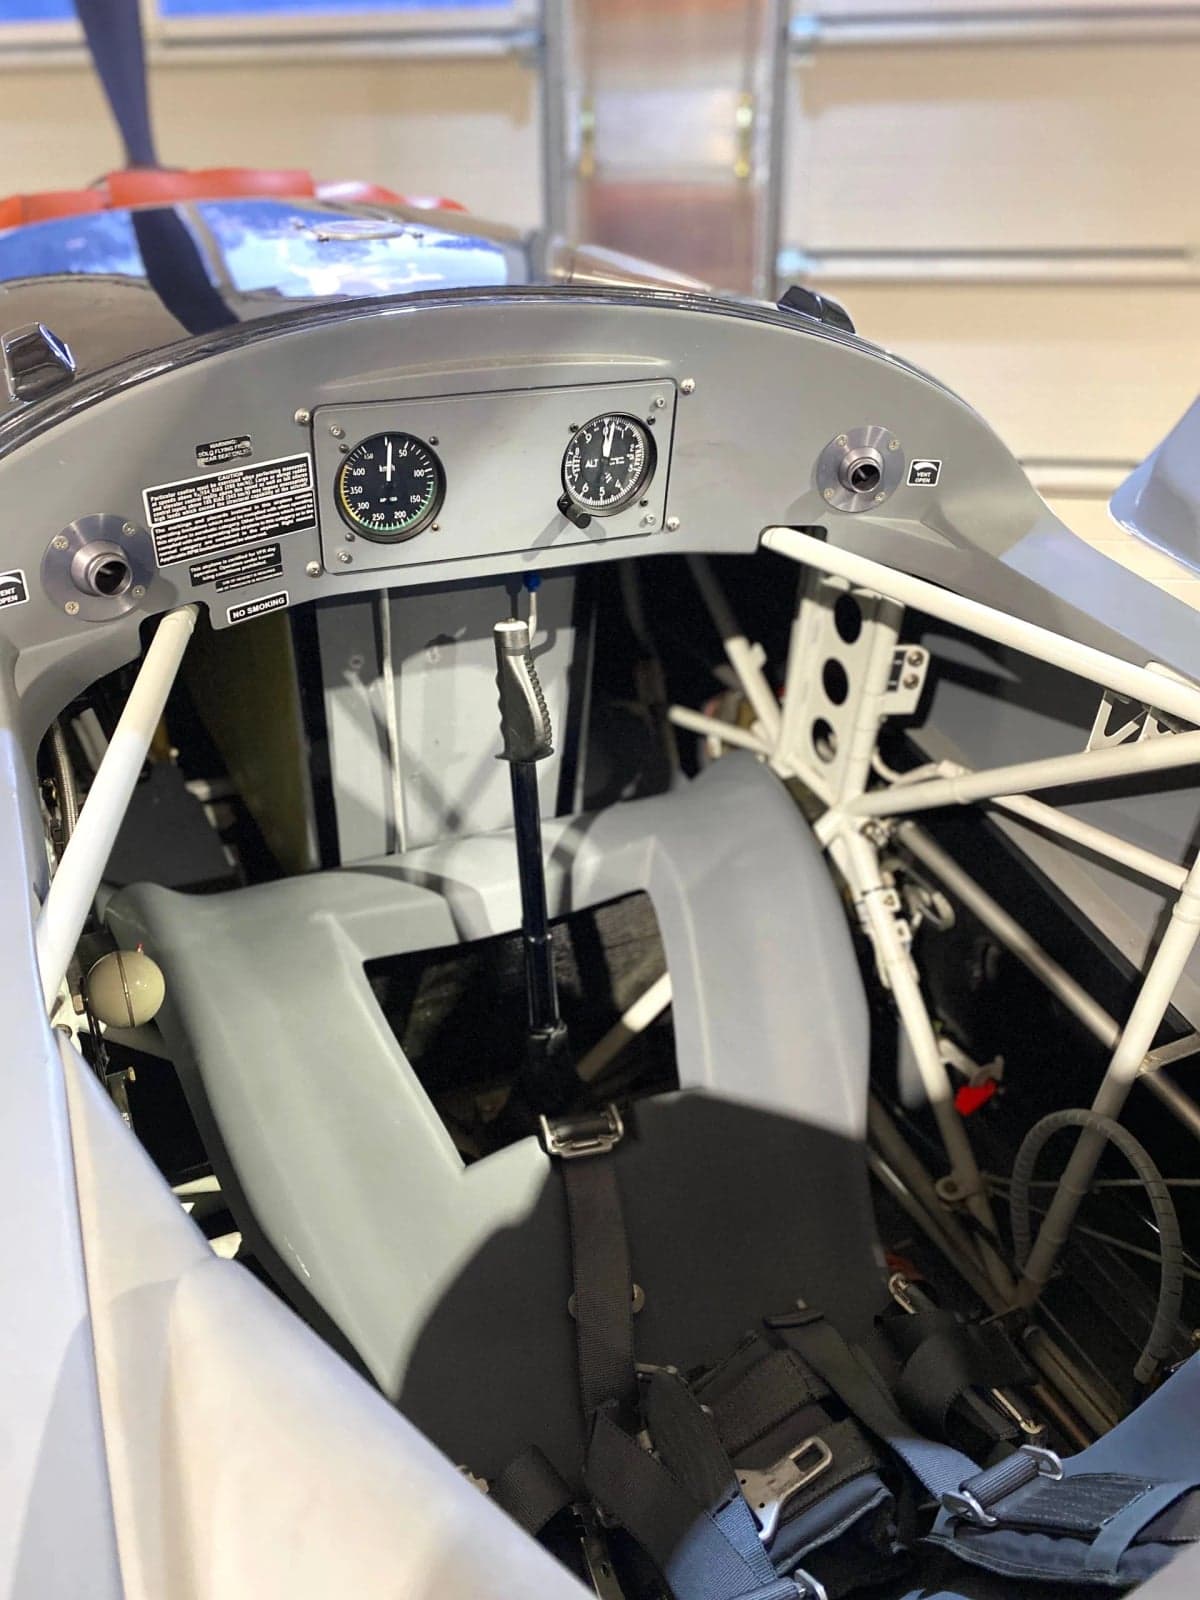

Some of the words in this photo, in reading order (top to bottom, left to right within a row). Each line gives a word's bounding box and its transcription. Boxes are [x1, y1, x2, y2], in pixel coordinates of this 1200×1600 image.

[585, 434, 592, 444] 9
[214, 446, 233, 454] FLYING
[585, 459, 599, 468] ALT
[350, 486, 362, 494] 350
[582, 483, 589, 492] 6
[0, 587, 16, 596] ENT
[233, 610, 245, 618] NO
[247, 598, 284, 614] SMOKING
